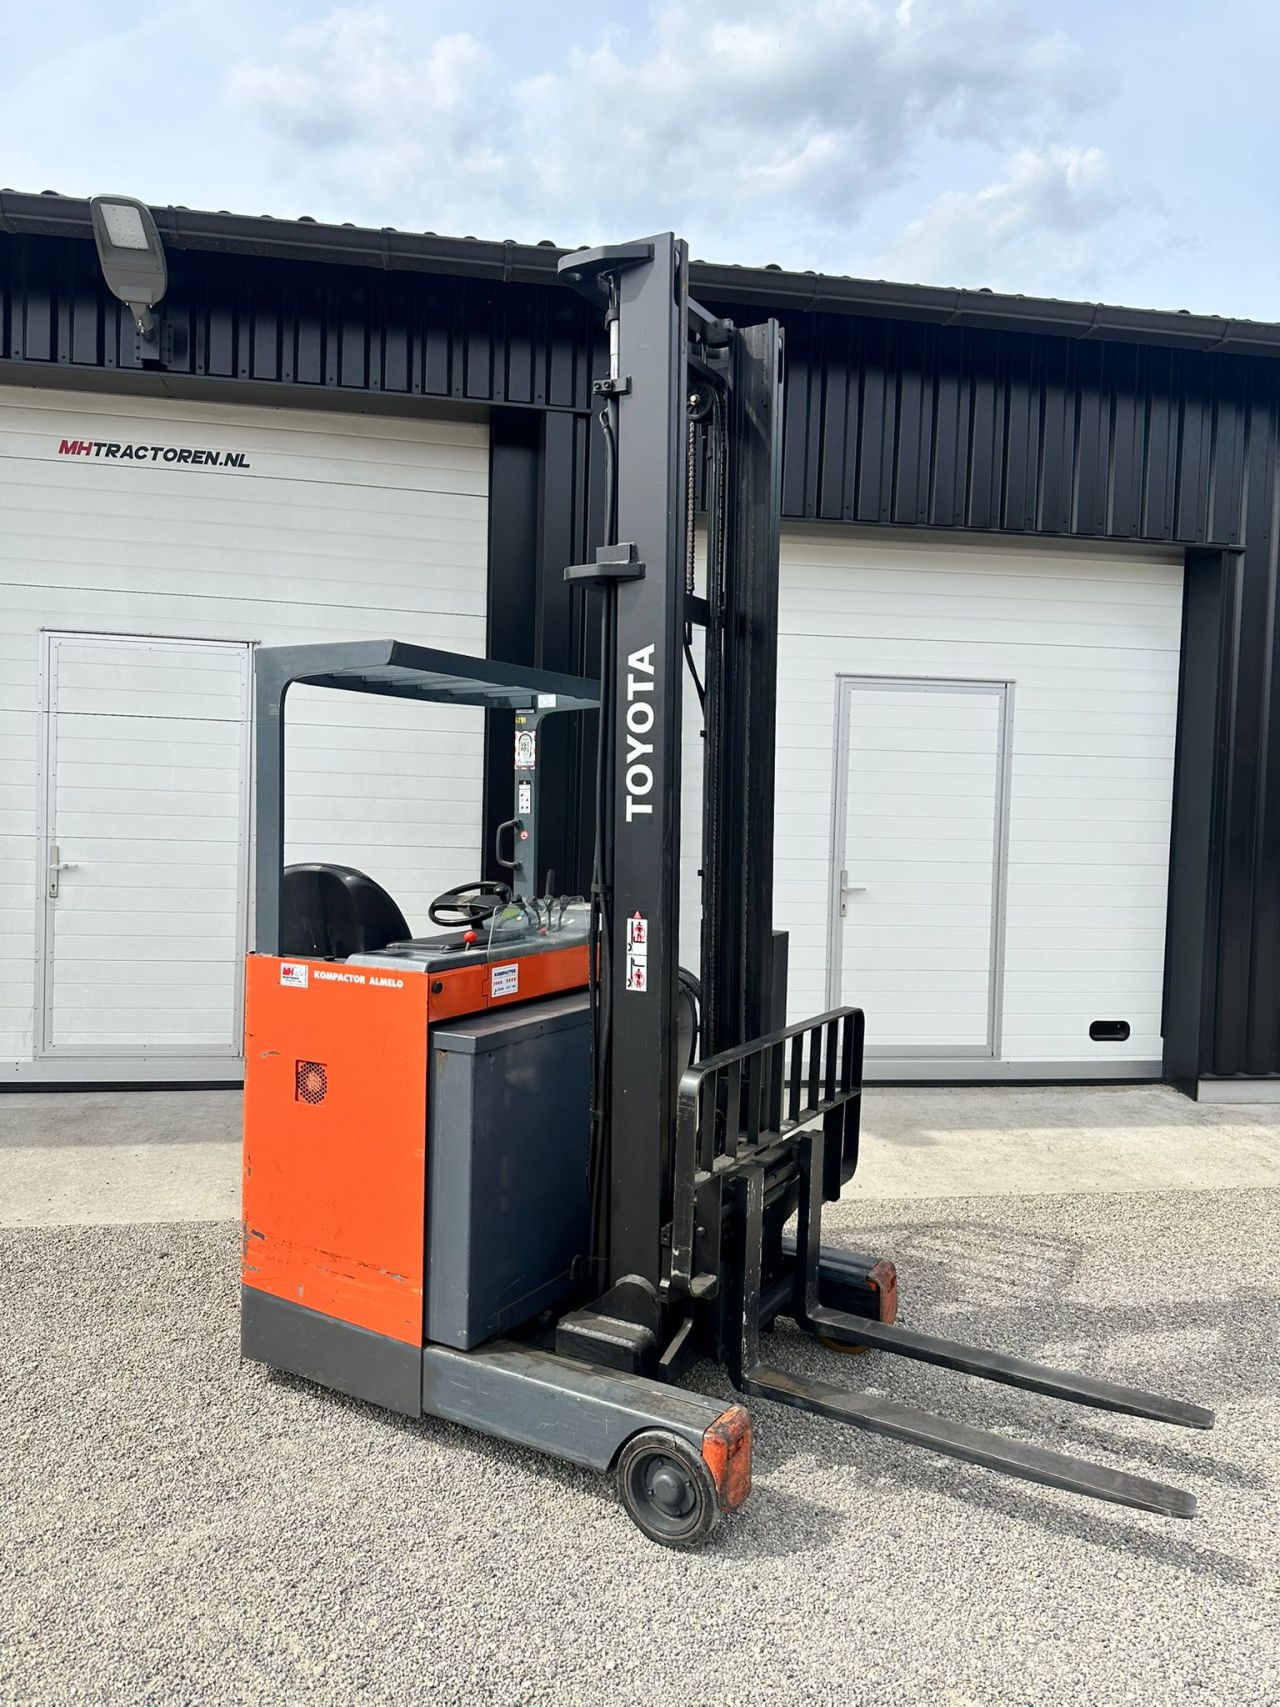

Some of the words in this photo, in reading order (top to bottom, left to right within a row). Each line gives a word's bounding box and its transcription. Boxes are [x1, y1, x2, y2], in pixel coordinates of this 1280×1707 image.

[59, 440, 250, 468] MHTRACTOREN.NL
[626, 643, 655, 822] TOYOTA
[314, 970, 366, 984] KOMPACTOR
[369, 976, 404, 988] ALMELO
